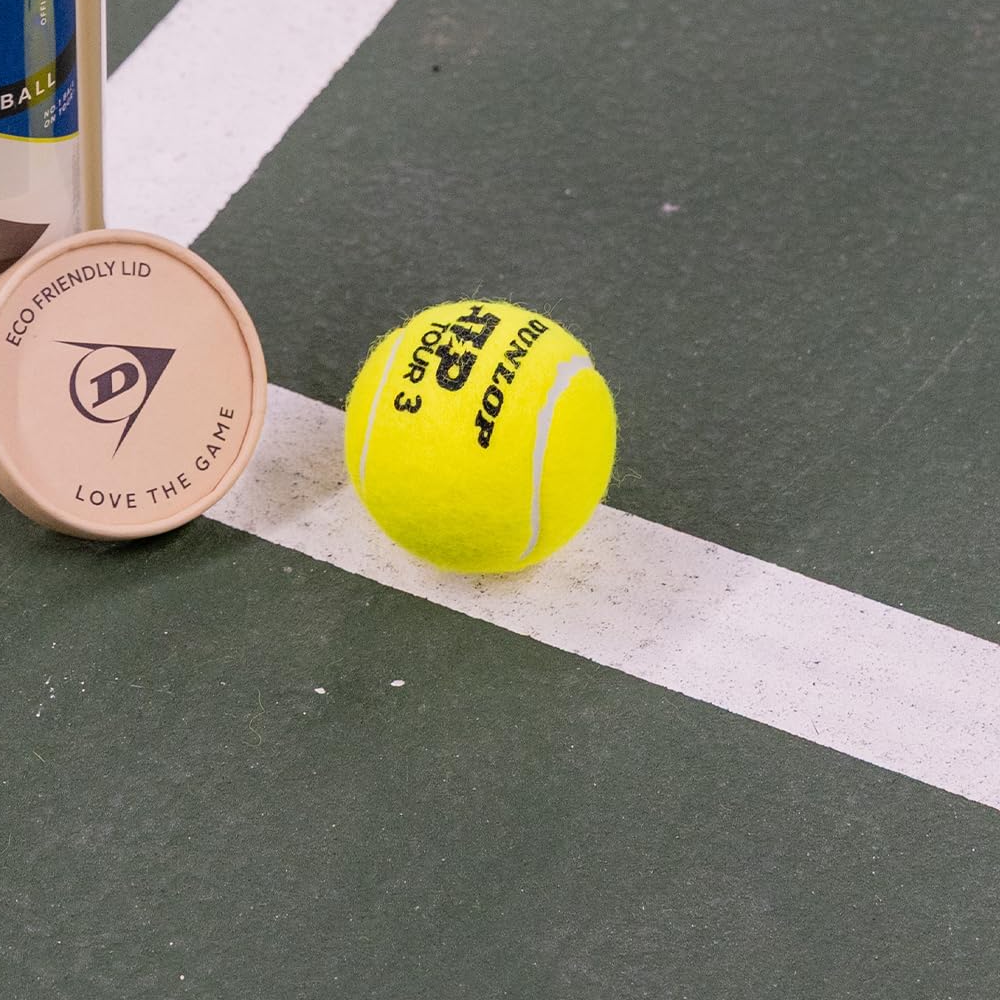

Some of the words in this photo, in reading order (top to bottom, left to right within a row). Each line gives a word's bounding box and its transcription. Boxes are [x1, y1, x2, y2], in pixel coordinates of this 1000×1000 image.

[0, 72, 56, 110] BALL
[43, 113, 57, 128] ON
[5, 307, 35, 348] ECO
[32, 260, 116, 310] FRIENDLY
[121, 260, 152, 278] LID
[402, 322, 451, 384] TOUR
[435, 304, 501, 392] ATP
[474, 318, 549, 449] DUNLOP
[393, 391, 422, 414] 3
[75, 484, 138, 509] LOVE
[146, 472, 192, 505] THE
[195, 405, 235, 472] GAME
